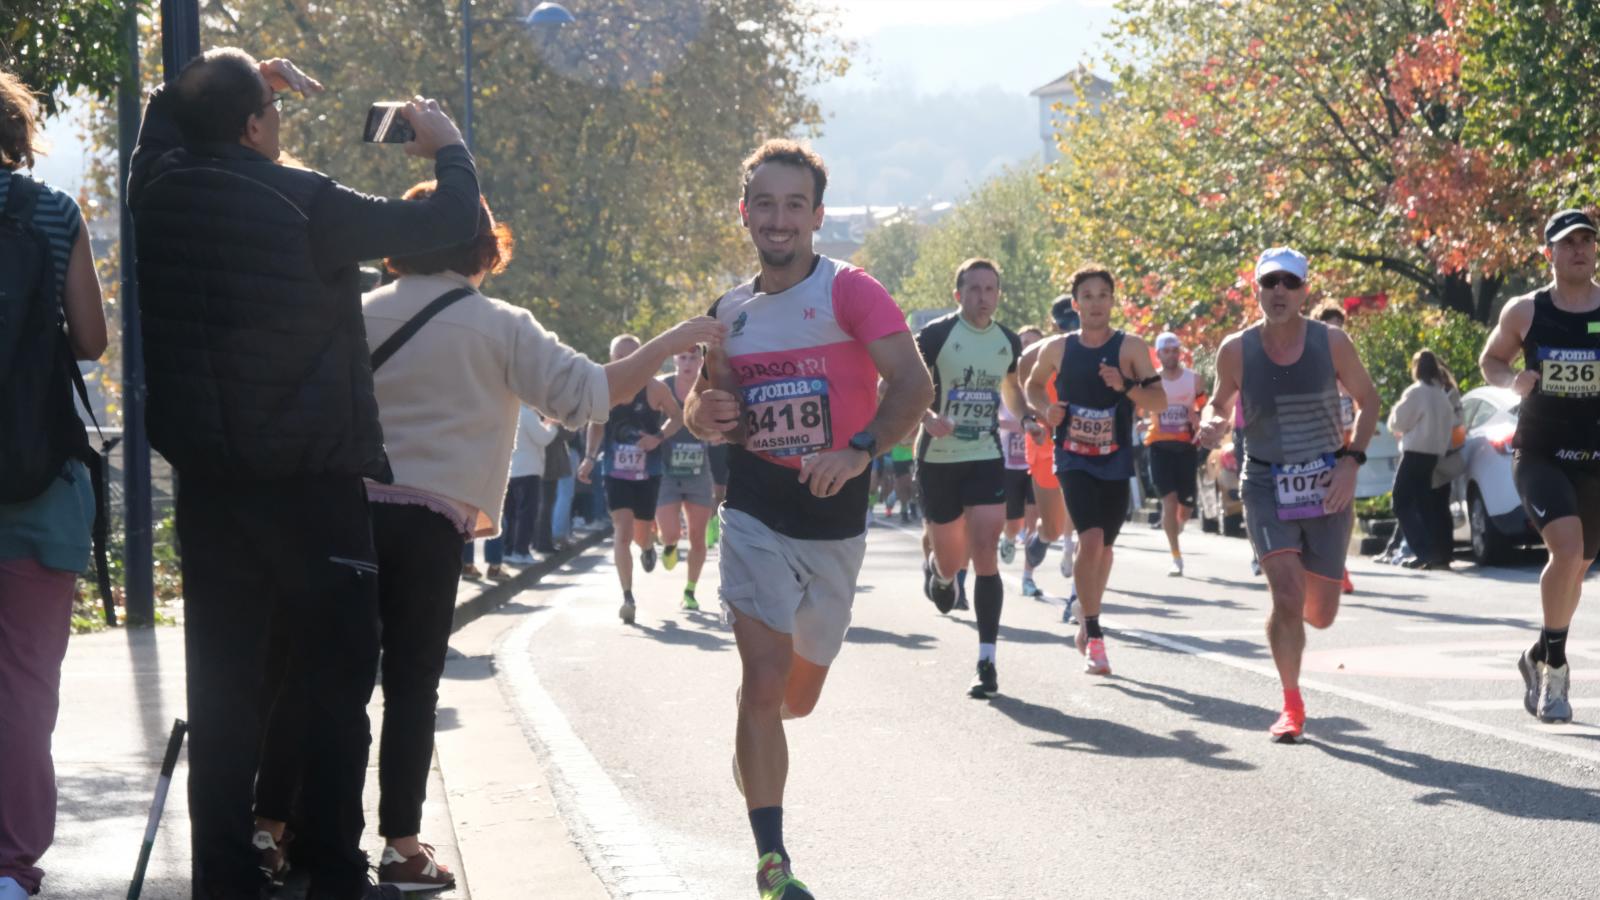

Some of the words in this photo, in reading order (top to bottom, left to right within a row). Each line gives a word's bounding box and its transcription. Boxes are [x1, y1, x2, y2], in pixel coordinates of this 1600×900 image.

[1549, 364, 1594, 382] 236
[758, 380, 811, 402] Joma
[951, 403, 993, 418] 1792
[746, 401, 821, 438] 3418
[1072, 419, 1112, 436] 3692
[753, 434, 810, 448] MASSIMO
[618, 452, 642, 464] 617
